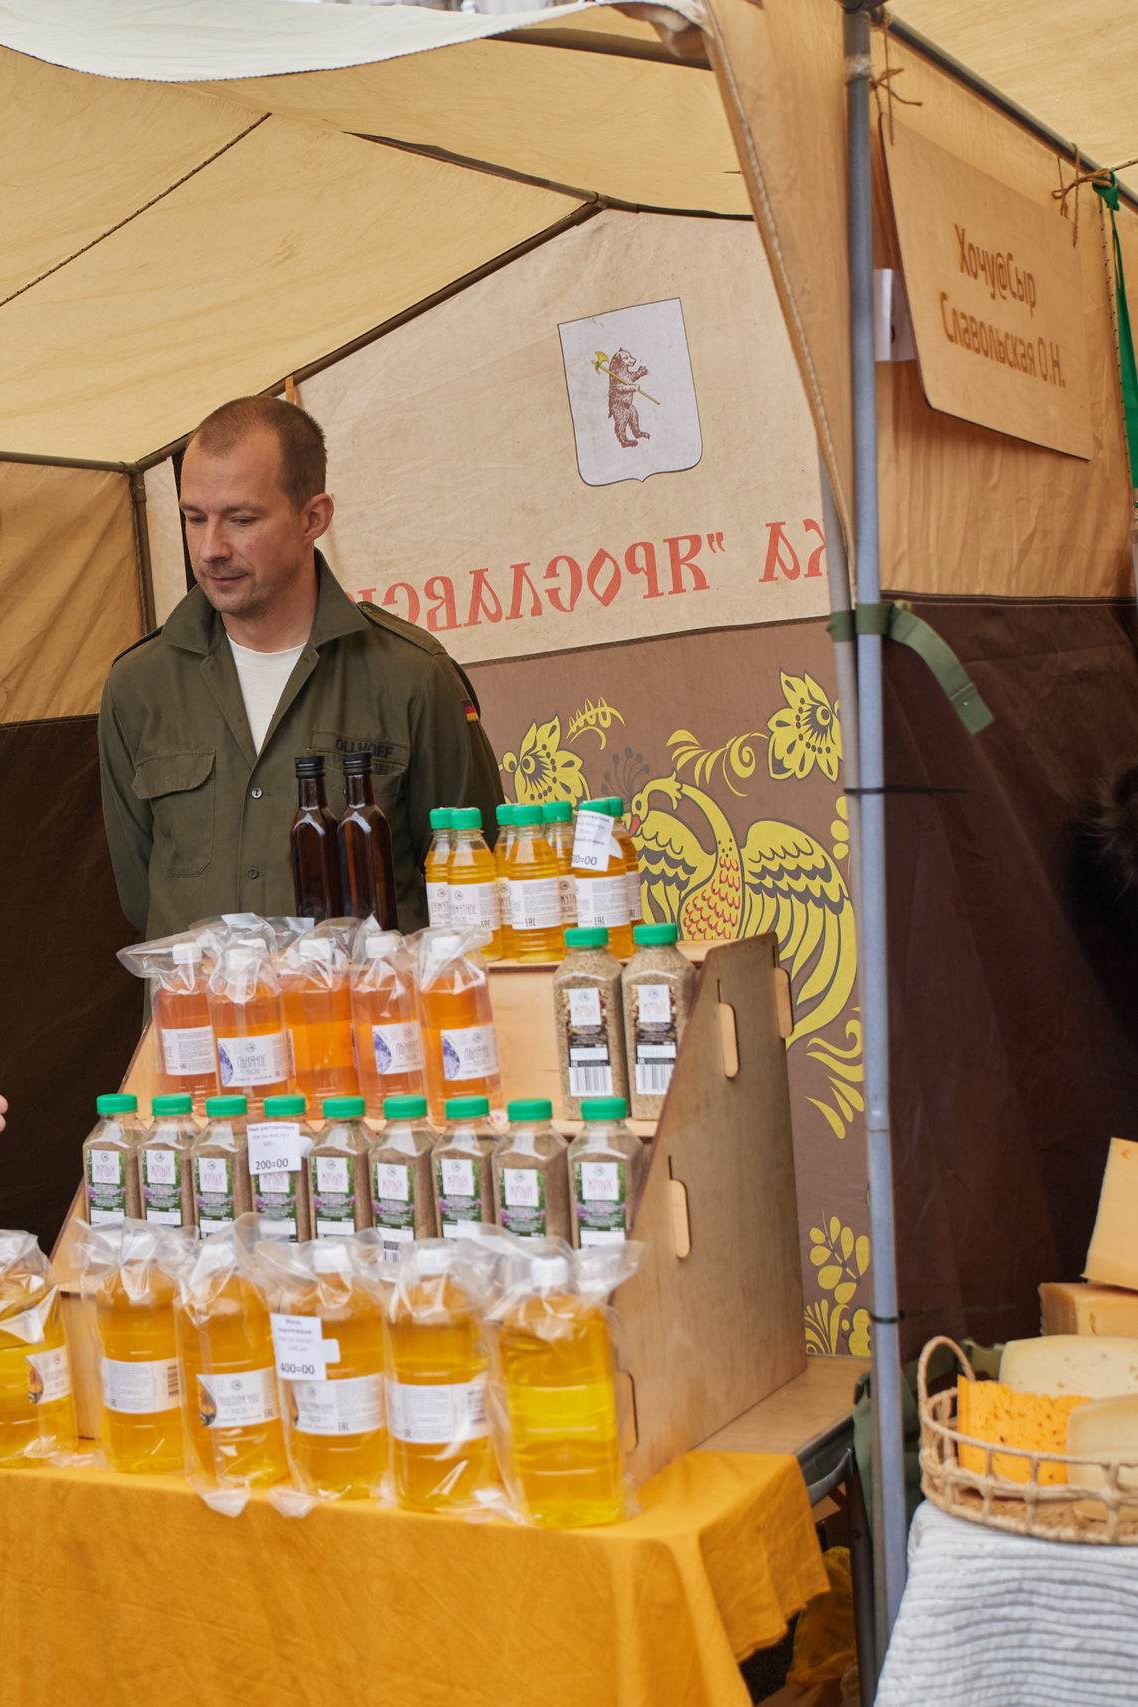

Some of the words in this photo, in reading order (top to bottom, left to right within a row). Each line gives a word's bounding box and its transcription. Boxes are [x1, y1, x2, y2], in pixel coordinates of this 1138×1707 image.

[954, 223, 1037, 318] Хочу@Сыр
[939, 291, 1037, 378] Славольская
[255, 1158, 289, 1170] 200=00
